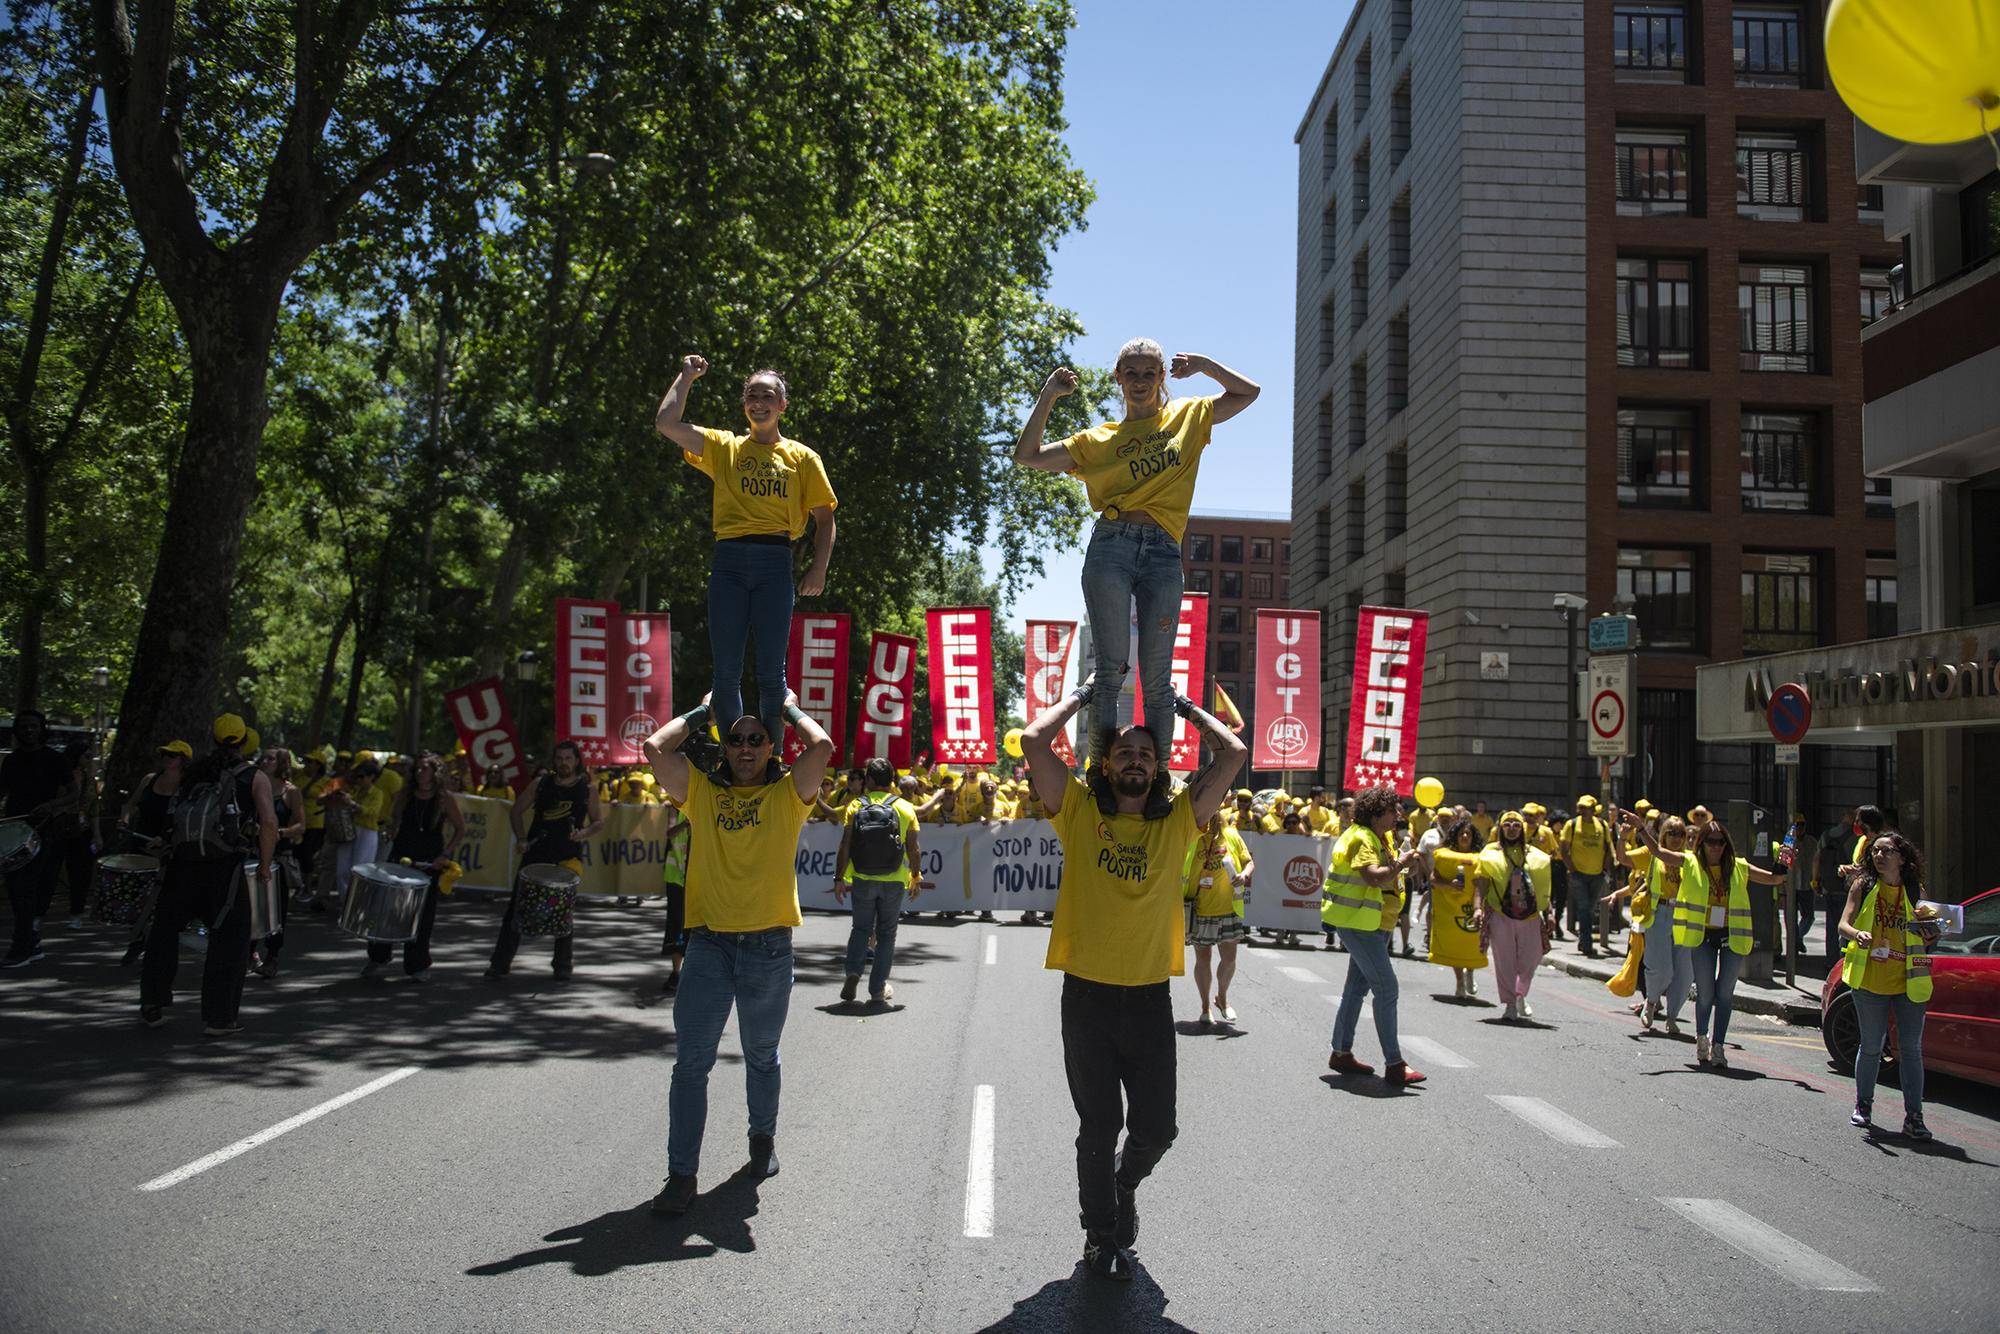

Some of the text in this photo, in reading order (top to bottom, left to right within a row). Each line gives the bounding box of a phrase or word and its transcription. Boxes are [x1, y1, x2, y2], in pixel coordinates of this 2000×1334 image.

[1129, 448, 1181, 480] POSTAL
[741, 476, 788, 498] POSTAL
[626, 620, 653, 711] UGT
[941, 613, 981, 740] CCOO
[1033, 624, 1071, 718] UG
[1276, 618, 1301, 714] UGT
[863, 641, 910, 759] UGT
[1361, 615, 1413, 764] CCOO
[1272, 723, 1302, 741] UGT
[1753, 809, 1764, 825] P
[993, 837, 1032, 857] STOP
[1098, 848, 1148, 882] POSTAL
[1289, 861, 1319, 881] UGT
